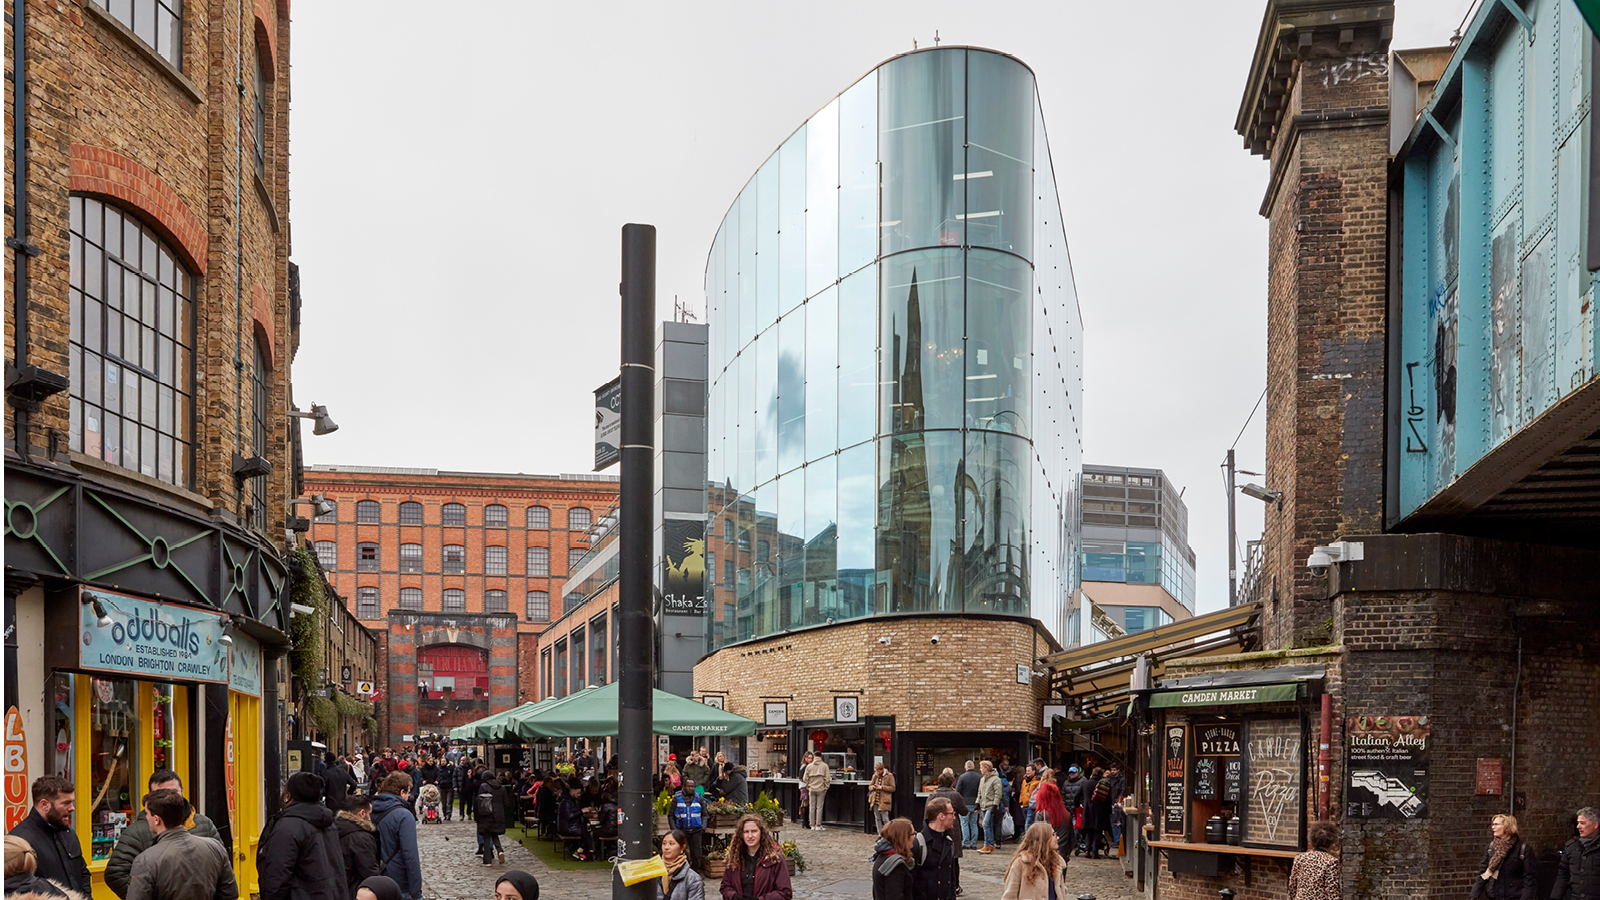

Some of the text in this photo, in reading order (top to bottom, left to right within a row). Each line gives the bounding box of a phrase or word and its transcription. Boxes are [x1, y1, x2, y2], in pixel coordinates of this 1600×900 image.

[664, 593, 693, 609] Shaka
[111, 607, 200, 656] oddballs
[135, 645, 178, 658] ESTABLISHED
[99, 653, 211, 676] LONDON BRIGHTON CRAWLEY
[1182, 689, 1257, 703] CAMDEN MARKET
[1202, 741, 1240, 752] PIZZA
[1248, 736, 1300, 762] CAMDEN
[1351, 733, 1426, 750] Italian Alley
[1167, 757, 1184, 770] PIZZA
[1167, 770, 1184, 778] MENU
[1253, 770, 1297, 811] Pizza
